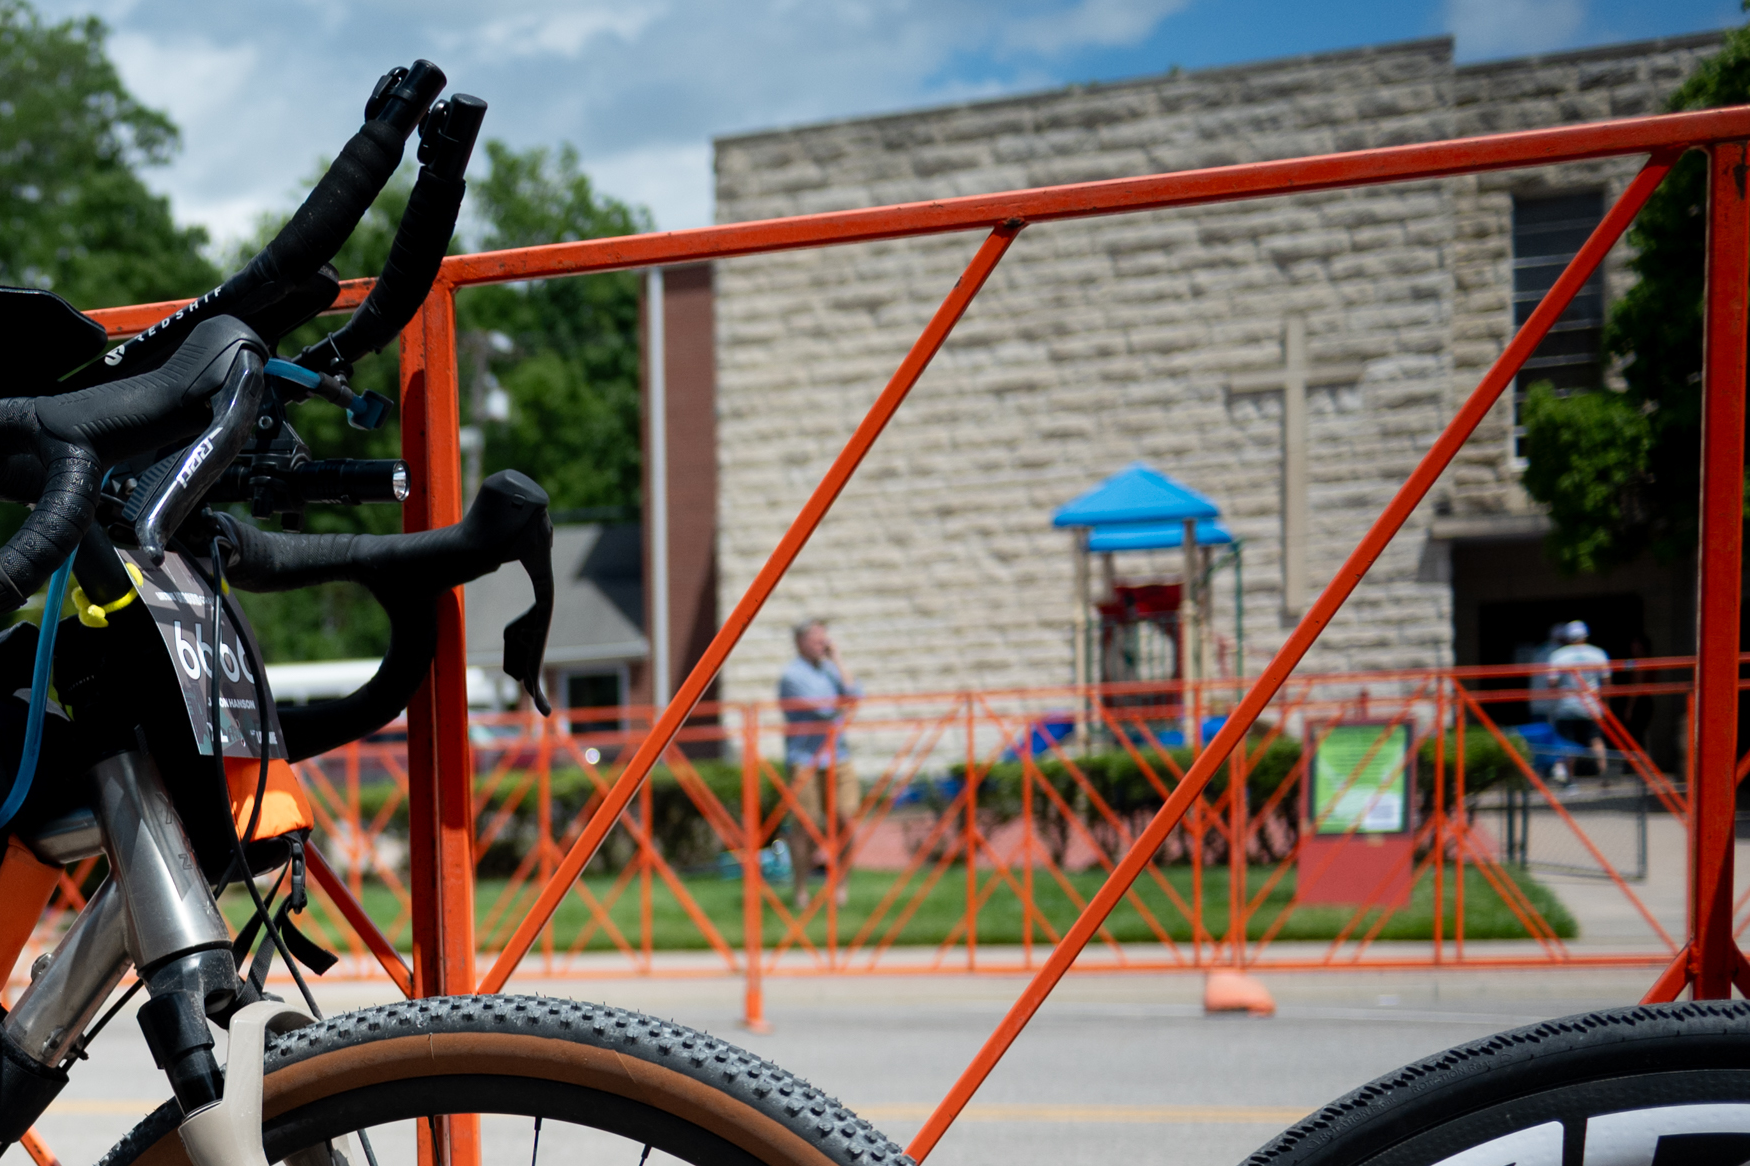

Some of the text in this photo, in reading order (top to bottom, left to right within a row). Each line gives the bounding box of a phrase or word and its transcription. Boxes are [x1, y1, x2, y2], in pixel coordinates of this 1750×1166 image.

[207, 696, 256, 710] JON HANSON
[1412, 1068, 1465, 1094] ROTATION
